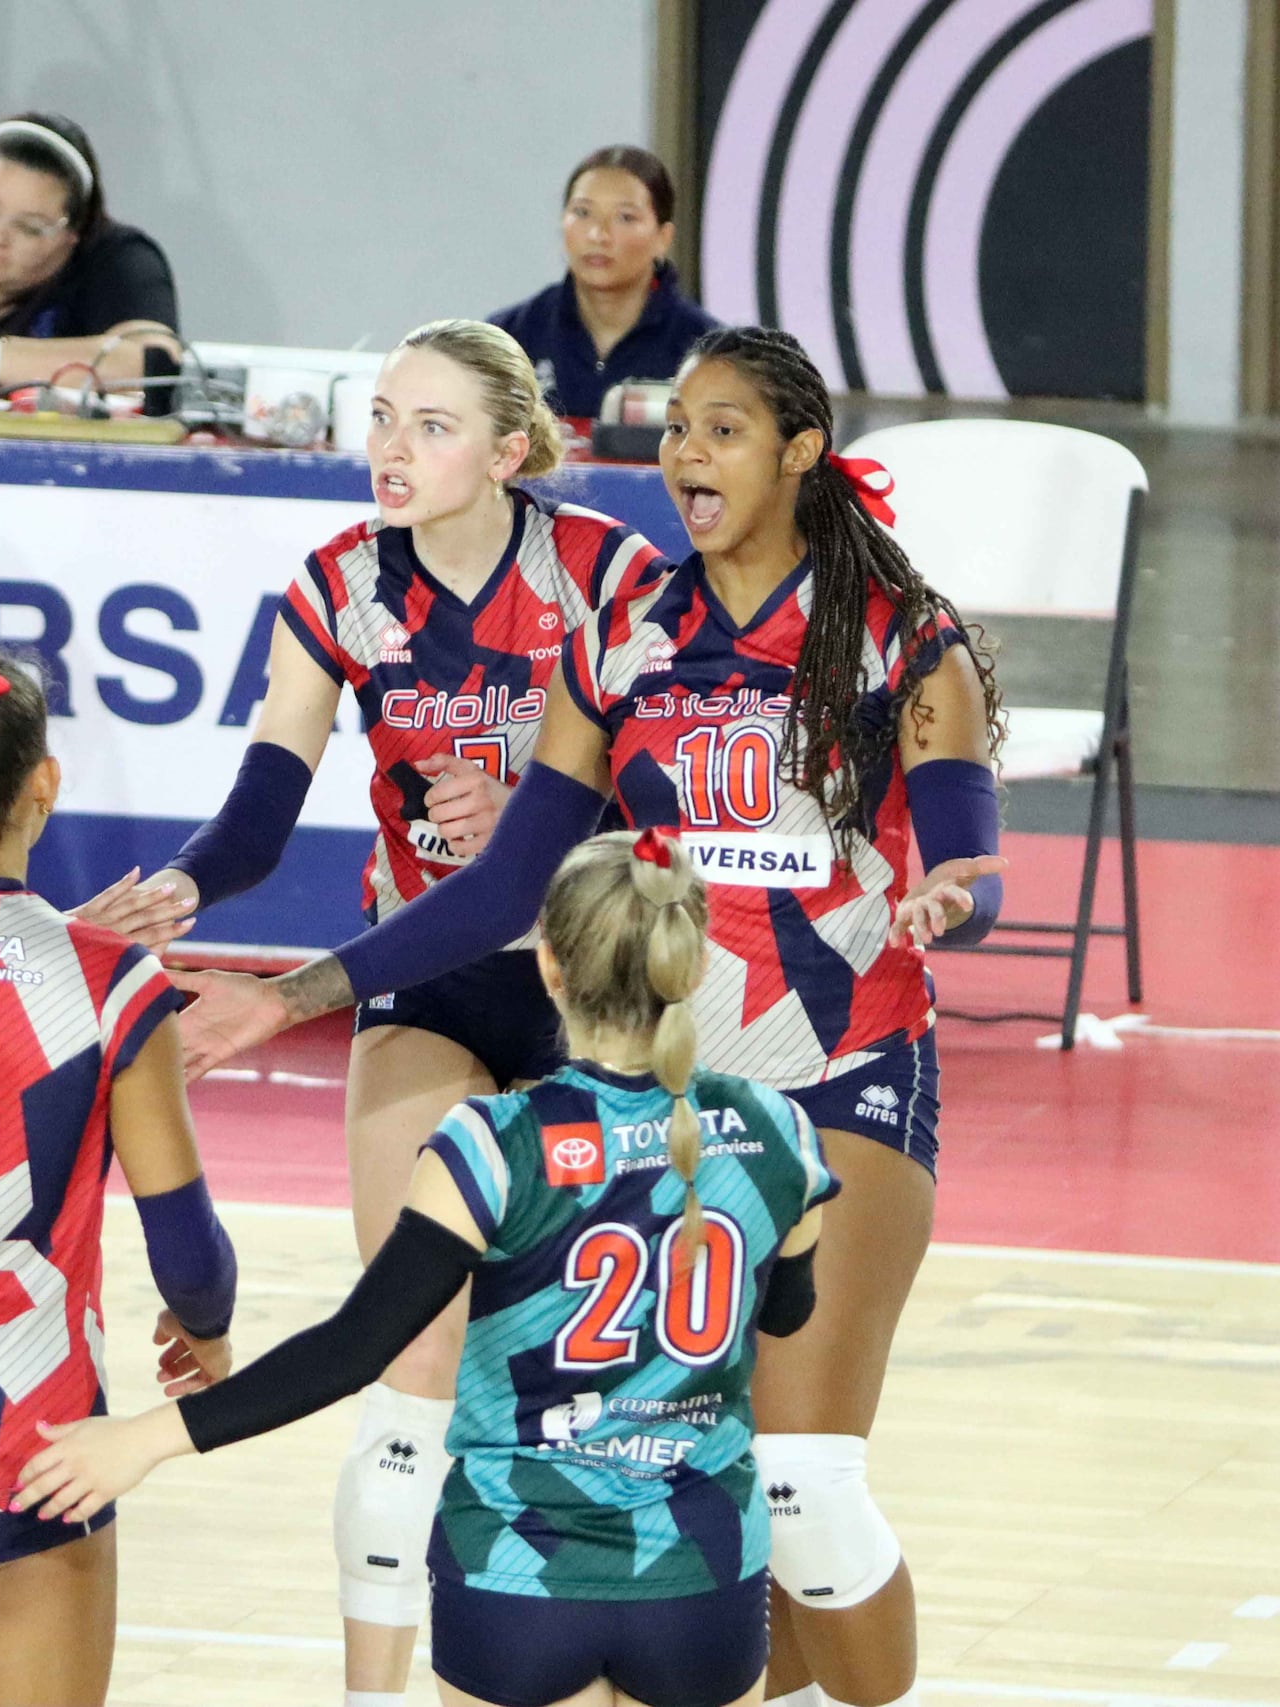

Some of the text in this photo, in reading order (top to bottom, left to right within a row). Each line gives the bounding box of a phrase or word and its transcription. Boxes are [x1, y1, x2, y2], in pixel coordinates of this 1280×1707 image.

[527, 644, 562, 661] TOYO
[676, 725, 779, 827] 10
[688, 845, 817, 873] IVERSAL
[854, 1101, 899, 1126] errea
[612, 1107, 748, 1153] TOYTA
[615, 1154, 671, 1176] Financi
[554, 1205, 748, 1371] 20
[378, 1457, 415, 1475] errea
